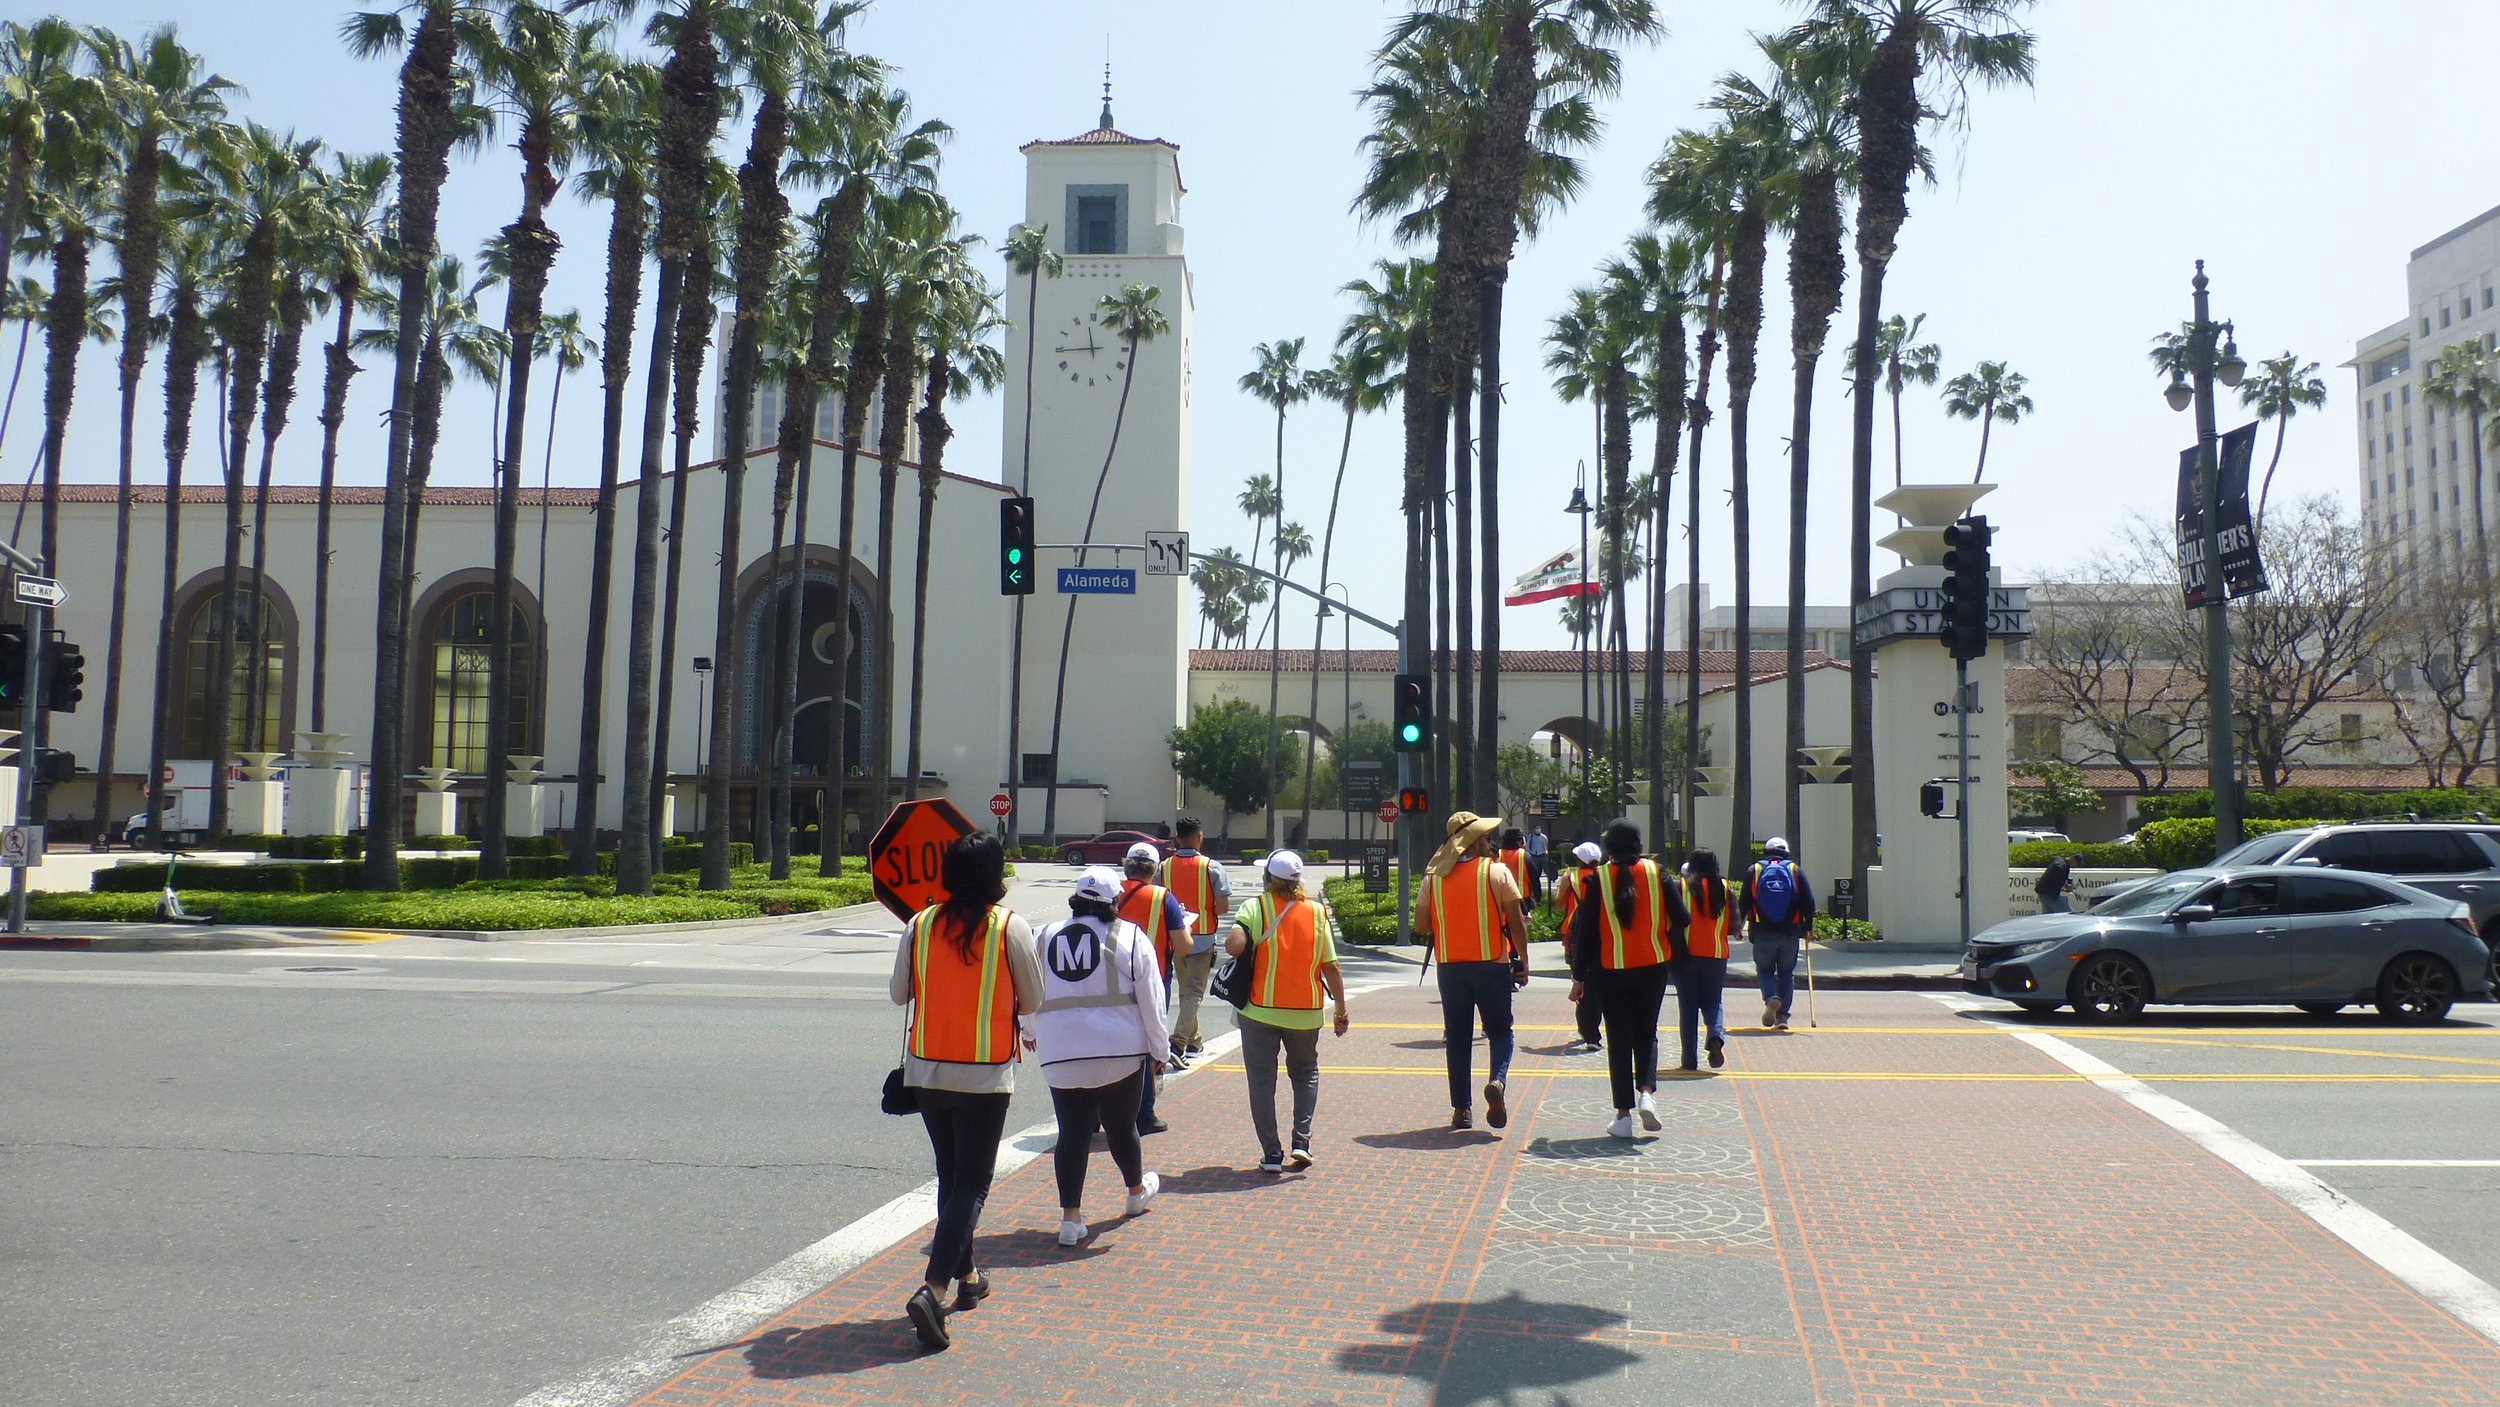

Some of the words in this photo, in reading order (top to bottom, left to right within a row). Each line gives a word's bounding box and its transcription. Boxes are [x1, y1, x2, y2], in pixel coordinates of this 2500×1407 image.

[1148, 564, 1166, 573] ONLY
[1064, 573, 1129, 588] Alameda
[21, 583, 37, 595] ONE
[38, 586, 53, 598] WAY
[1915, 591, 2010, 609] UNN
[990, 800, 1011, 810] STOP
[1418, 794, 1426, 810] 6
[1378, 807, 1399, 817] STOP
[1366, 847, 1386, 855] SPEED
[886, 840, 952, 888] SLO
[1367, 855, 1384, 863] LIMIT
[1372, 864, 1380, 878] 5
[1057, 933, 1092, 972] M
